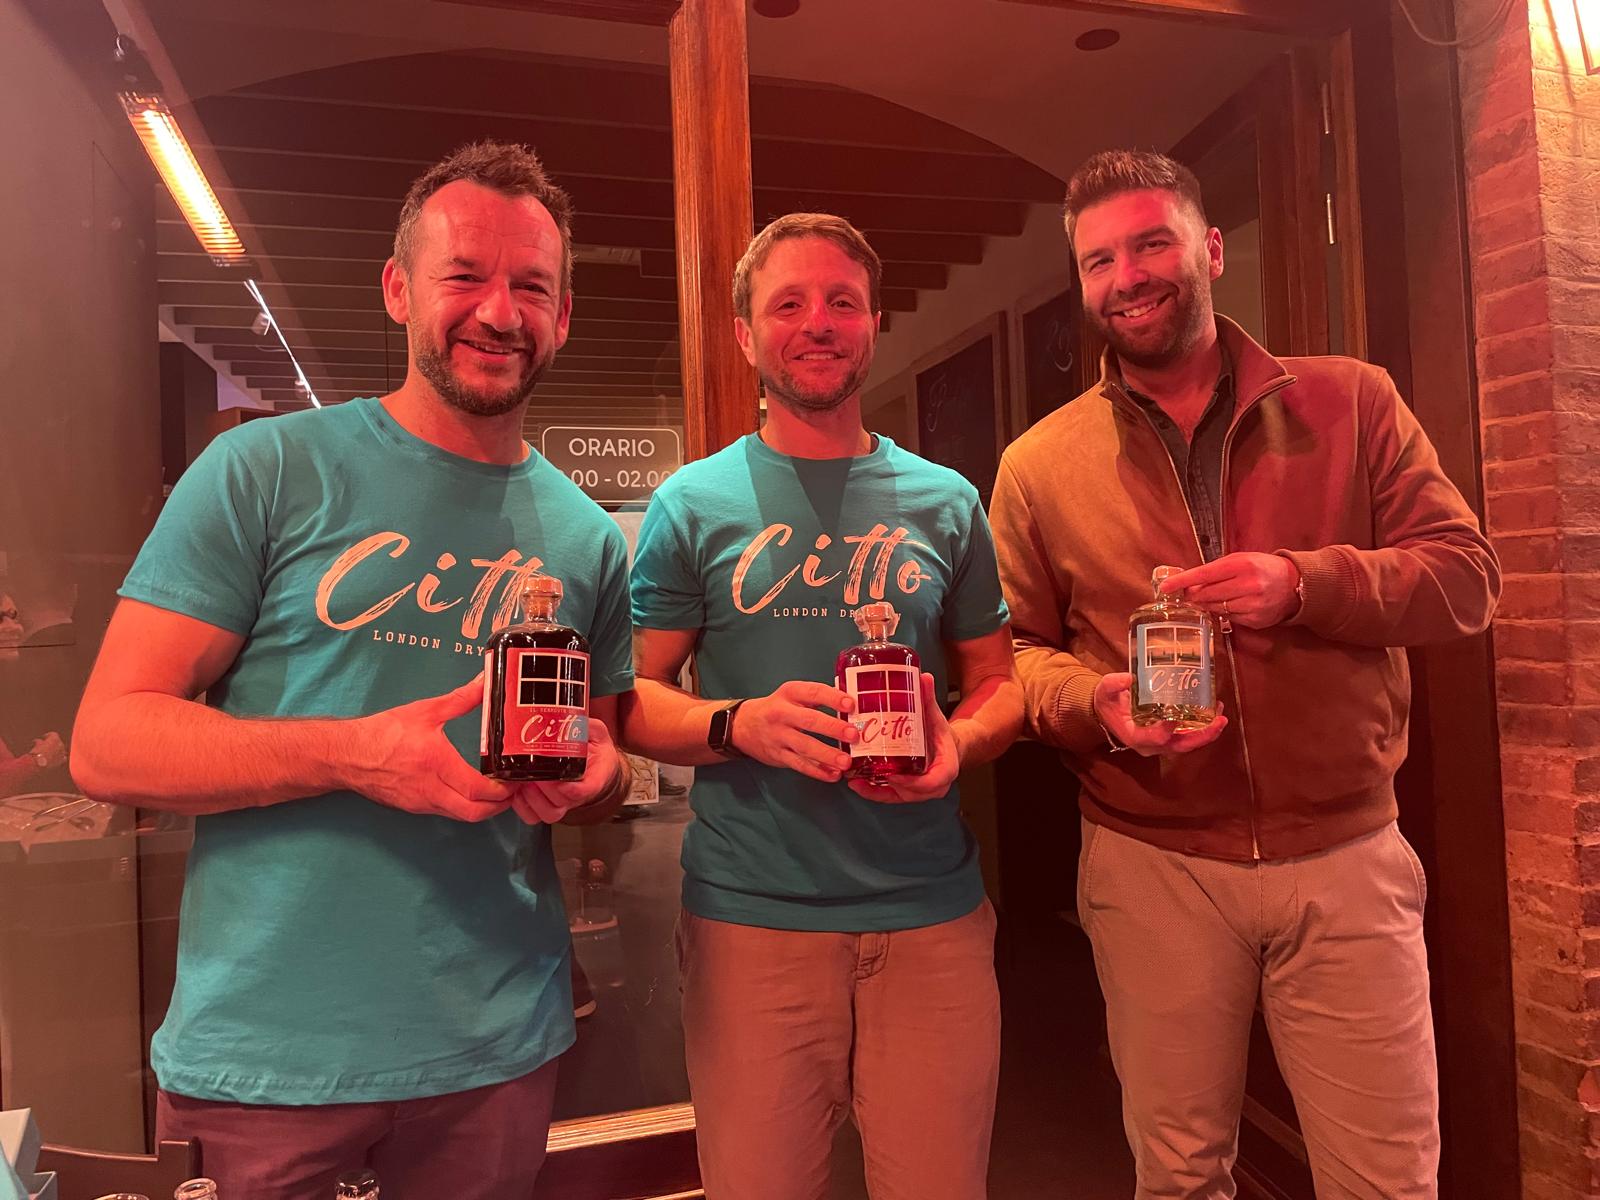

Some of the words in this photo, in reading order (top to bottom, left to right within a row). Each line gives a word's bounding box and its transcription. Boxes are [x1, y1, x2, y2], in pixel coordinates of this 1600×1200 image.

[568, 437, 656, 458] ORARIO
[731, 523, 932, 615] Citto
[315, 531, 544, 639] Citt
[773, 607, 828, 618] LONDON
[373, 629, 441, 649] LONDON
[454, 641, 485, 657] DRY
[1150, 669, 1201, 693] Citto
[520, 714, 582, 745] Citto
[862, 715, 914, 743] Citto
